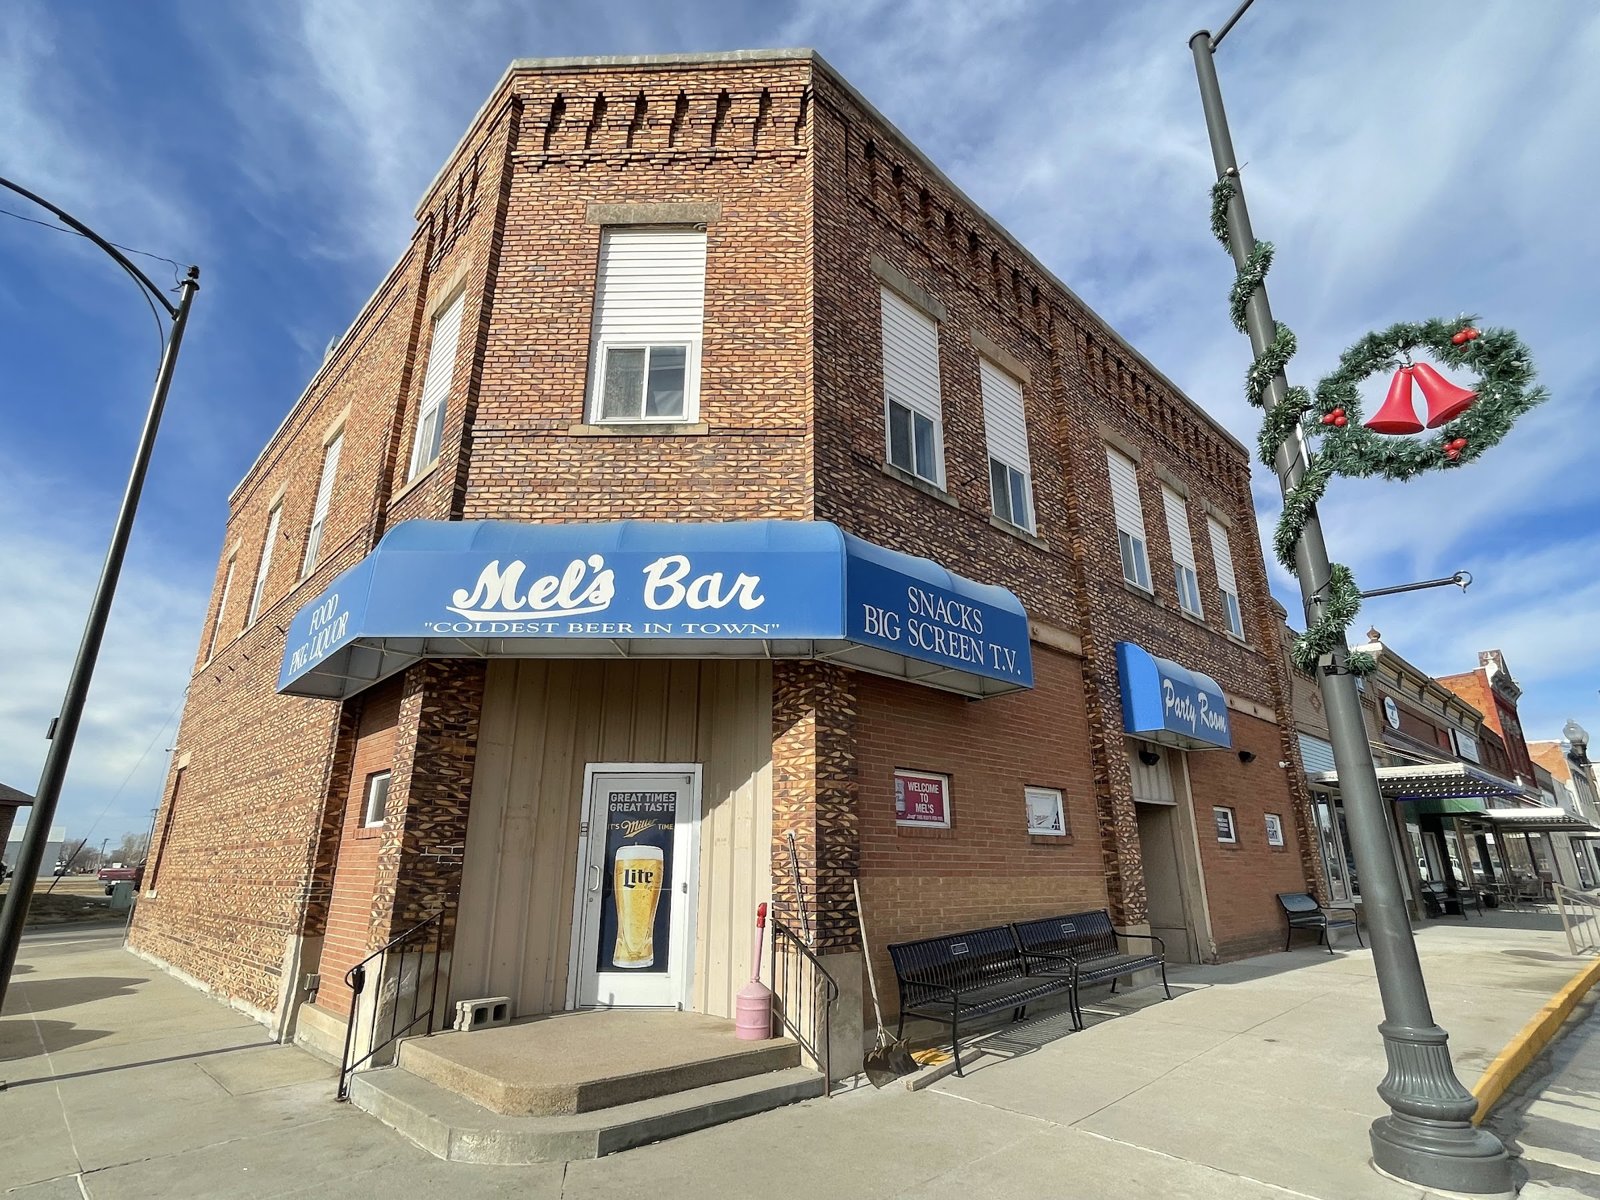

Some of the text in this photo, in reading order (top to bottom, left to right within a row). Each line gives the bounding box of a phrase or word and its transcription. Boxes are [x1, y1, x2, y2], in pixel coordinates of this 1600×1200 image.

[450, 554, 765, 614] Mel's Bar
[308, 593, 339, 636] FOOD
[907, 586, 984, 635] SNACKS
[308, 610, 349, 662] LIQUOR
[424, 622, 780, 634] "COLDEST BEER IN TOWN"
[862, 603, 1022, 676] BIG SCREEN T.V.
[1163, 678, 1228, 735] Party Room
[907, 781, 940, 794] WELCOME
[609, 802, 675, 812] GREAT TASTE
[610, 793, 675, 802] GREAT TIMES
[919, 793, 929, 804] TO
[915, 802, 935, 814] MEL'S
[620, 819, 659, 837] Miller
[623, 869, 654, 889] Lite
